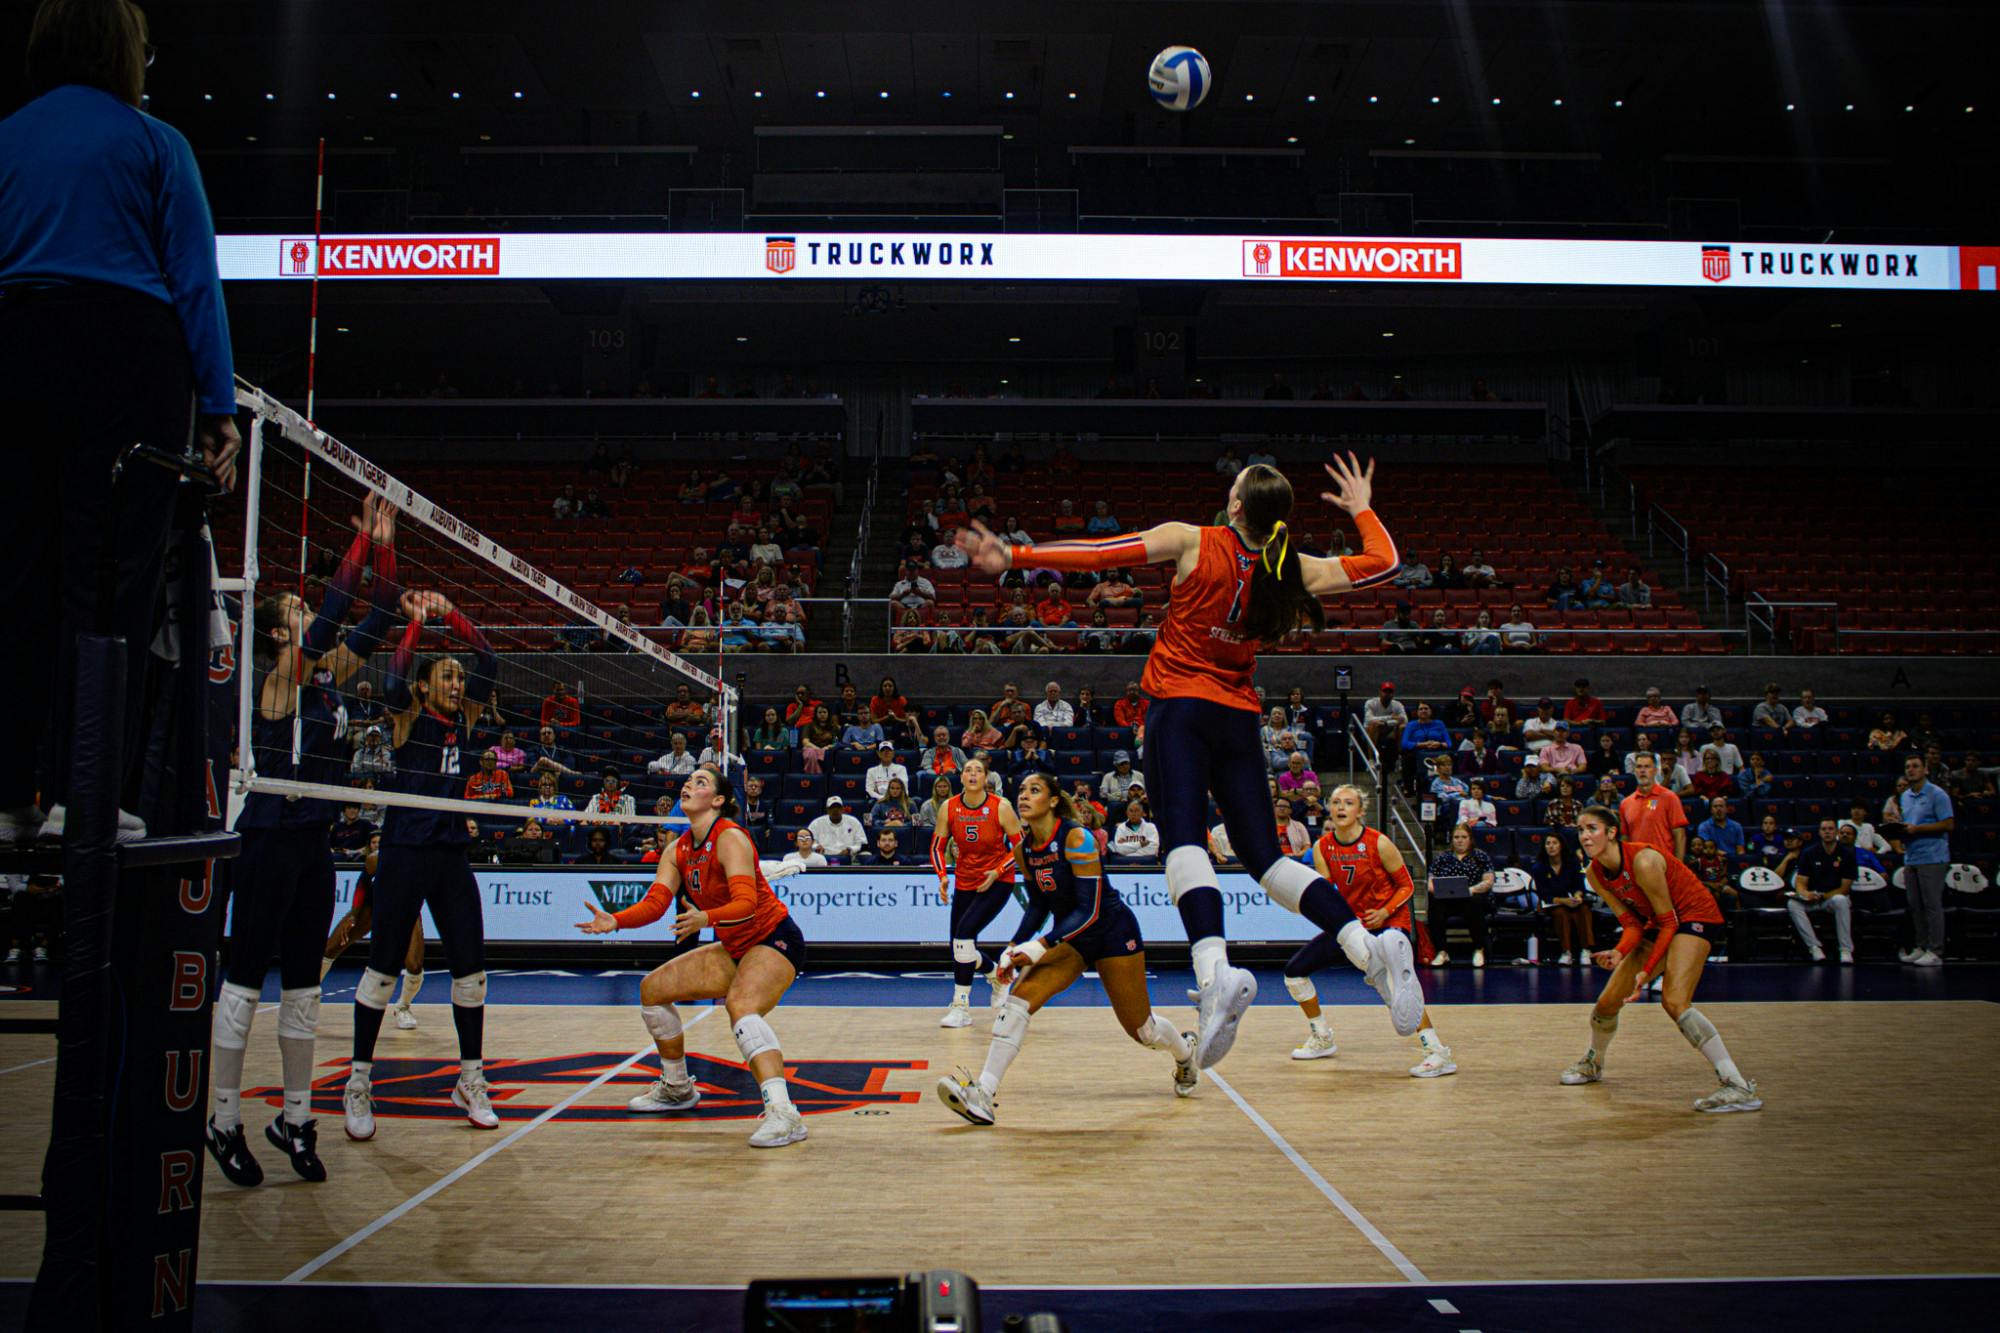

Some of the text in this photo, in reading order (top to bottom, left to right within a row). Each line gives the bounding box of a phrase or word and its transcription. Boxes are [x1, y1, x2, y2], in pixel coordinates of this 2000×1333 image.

[323, 244, 494, 270] KENWORTH
[808, 243, 993, 265] TRUCKWORX
[1286, 247, 1456, 273] KENWORTH
[1741, 252, 1918, 277] TRUCKWORX
[590, 329, 625, 348] 103
[1143, 331, 1181, 351] 102
[320, 436, 387, 490] AUBURN TIGERS
[430, 506, 458, 534] AUBURN
[836, 663, 850, 687] B
[1891, 666, 1911, 688] A
[440, 746, 461, 774] 12
[965, 824, 979, 843] 5
[1035, 867, 1057, 893] 15
[1341, 864, 1356, 886] 7
[489, 882, 552, 906] Trust
[601, 884, 644, 904] MPT
[774, 884, 954, 915] Properties Tru
